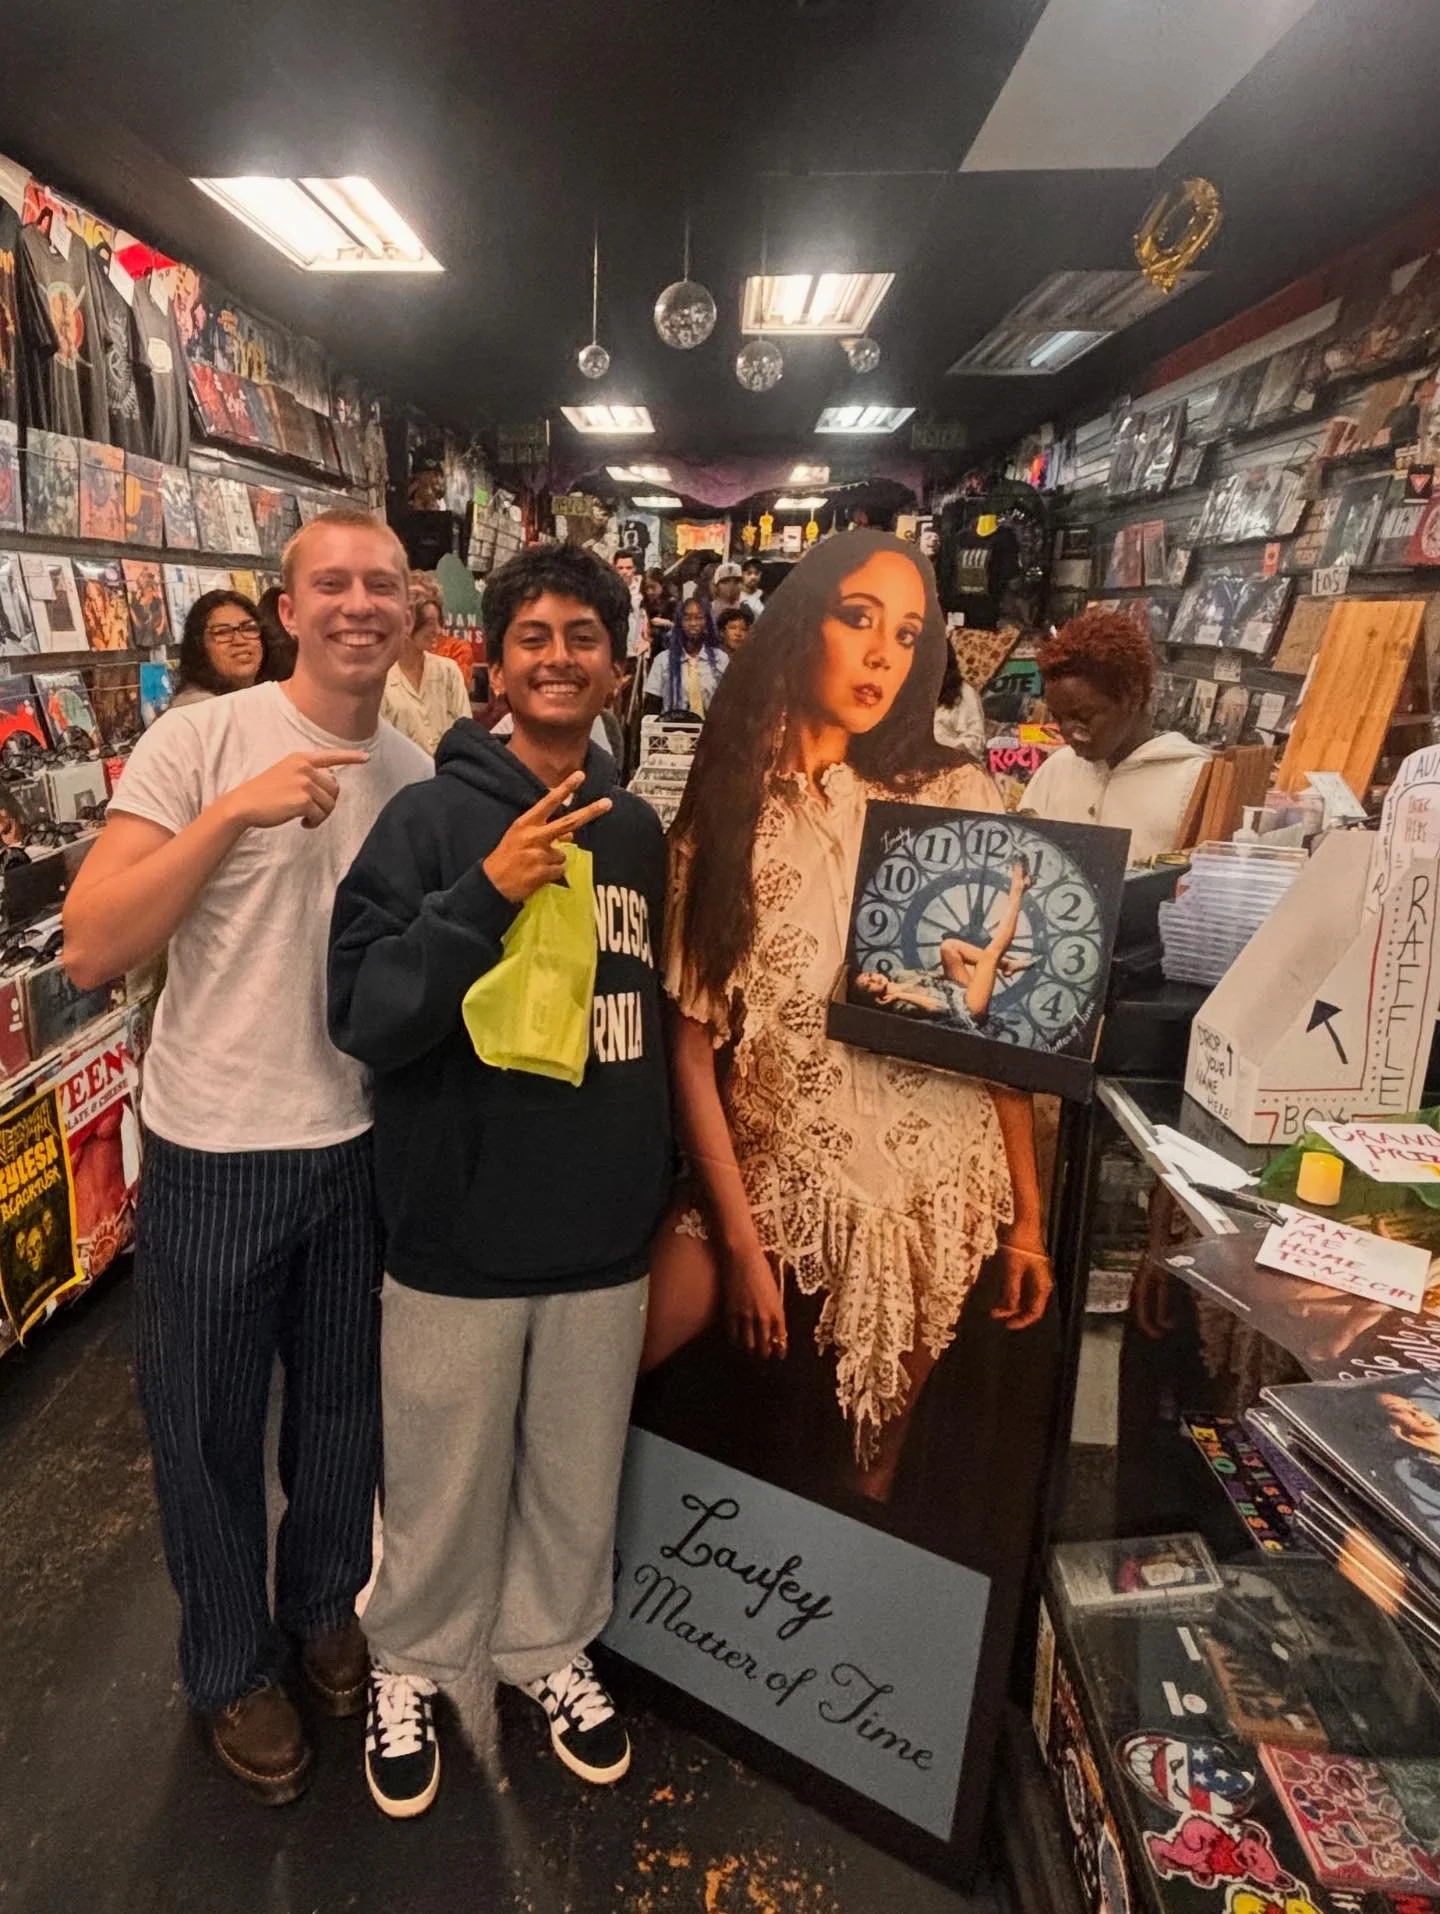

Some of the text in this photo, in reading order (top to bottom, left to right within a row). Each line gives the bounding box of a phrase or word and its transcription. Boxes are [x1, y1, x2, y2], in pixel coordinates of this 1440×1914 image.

[922, 834, 954, 865] 11
[972, 827, 1010, 858] 12
[882, 864, 917, 896] 10
[866, 908, 890, 938] 9
[1056, 892, 1084, 923] 2
[594, 884, 655, 970] NCISC
[1062, 943, 1087, 974] 3
[1040, 990, 1063, 1022] 4
[1378, 875, 1430, 1106] RAFFLE
[1287, 1230, 1344, 1250] ME
[1294, 1212, 1374, 1248] TAKE
[1278, 1239, 1370, 1269] HOME
[660, 1493, 833, 1641] Laufey
[629, 1563, 934, 1772] Matter of Time
